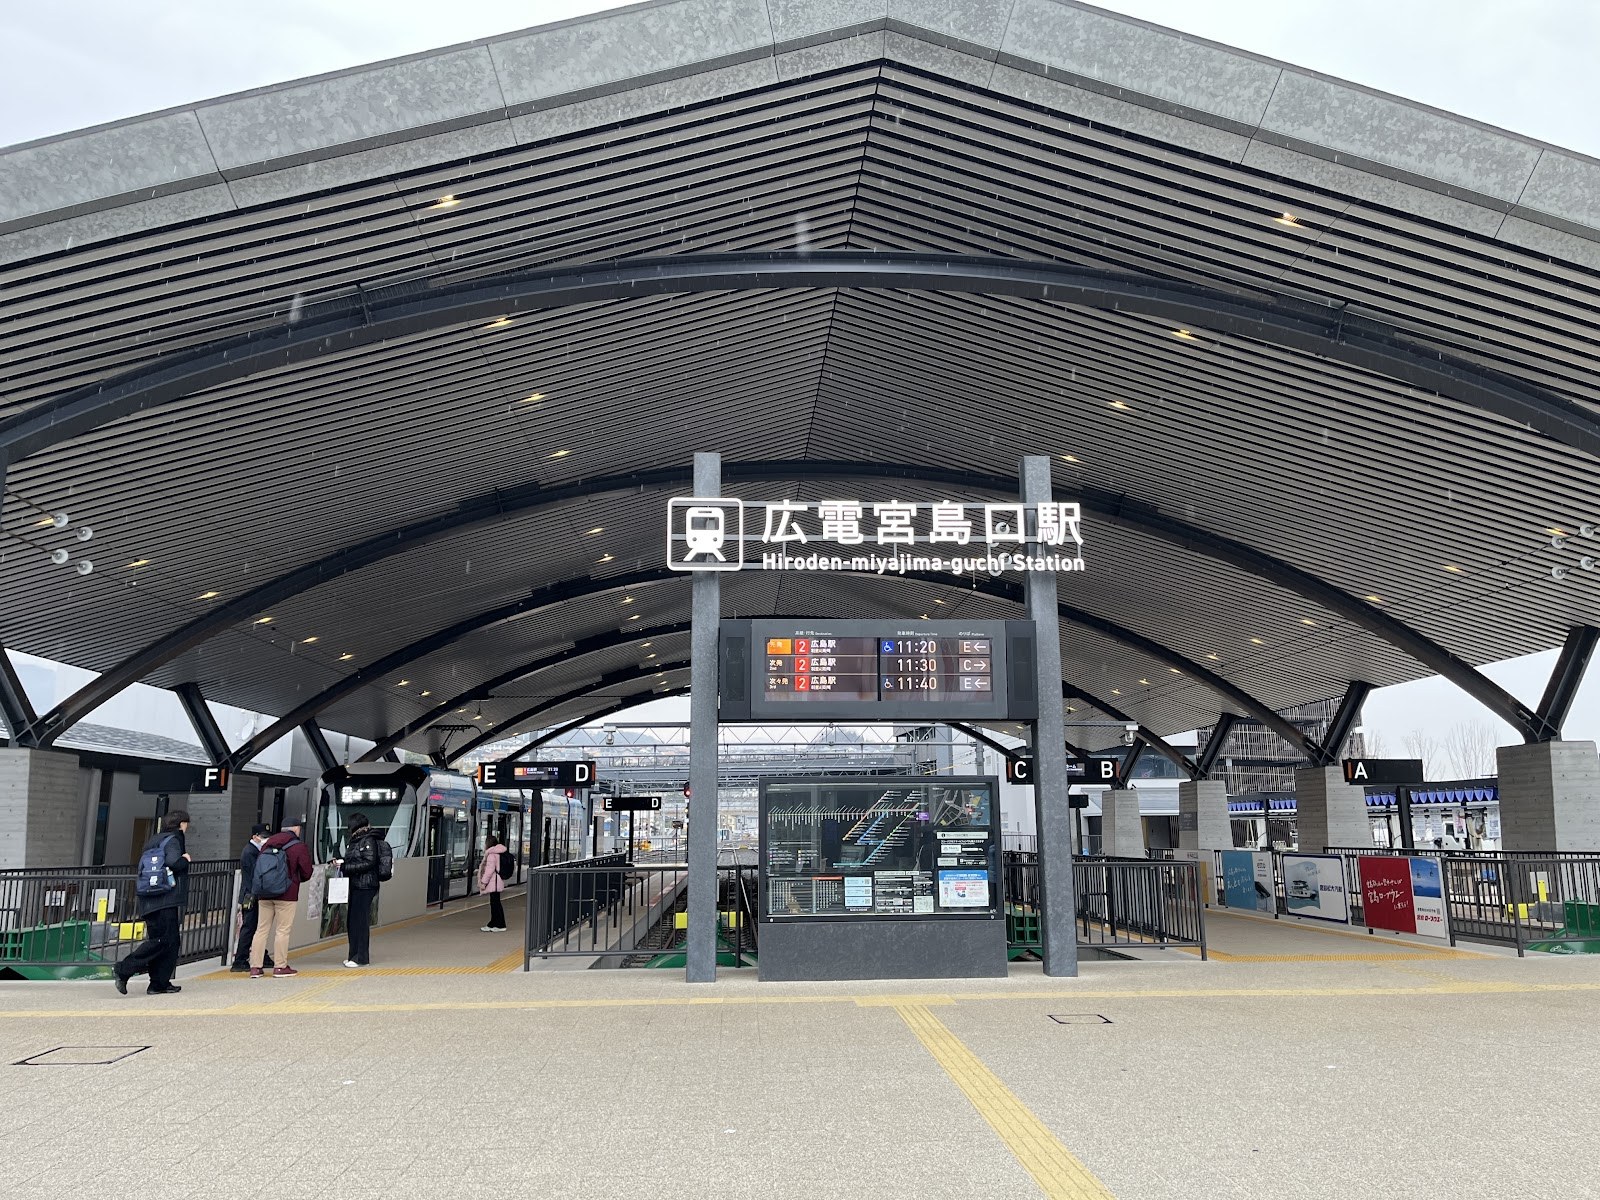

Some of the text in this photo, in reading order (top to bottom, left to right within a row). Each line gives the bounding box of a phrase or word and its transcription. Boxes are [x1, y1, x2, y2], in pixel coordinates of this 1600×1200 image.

[761, 499, 1084, 546] 広電宮島口駅
[762, 552, 1085, 575] Hiroden-miyajima-guchi Station
[798, 641, 806, 653] 2
[811, 639, 836, 648] 広島駅
[897, 640, 937, 654] 11:20
[963, 641, 971, 653] E
[798, 659, 806, 671] 2
[811, 657, 836, 666] 広島駅
[897, 658, 937, 672] 11:30
[963, 659, 972, 671] C
[798, 677, 806, 689] 2
[811, 676, 836, 685] 広島駅
[897, 676, 937, 690] 11:40
[964, 677, 972, 689] E
[484, 764, 497, 783] E
[575, 763, 589, 782] D
[1014, 761, 1027, 779] C
[1100, 760, 1114, 779] B
[1354, 761, 1368, 779] A
[204, 768, 218, 787] F
[605, 798, 613, 808] E
[651, 798, 659, 808] D
